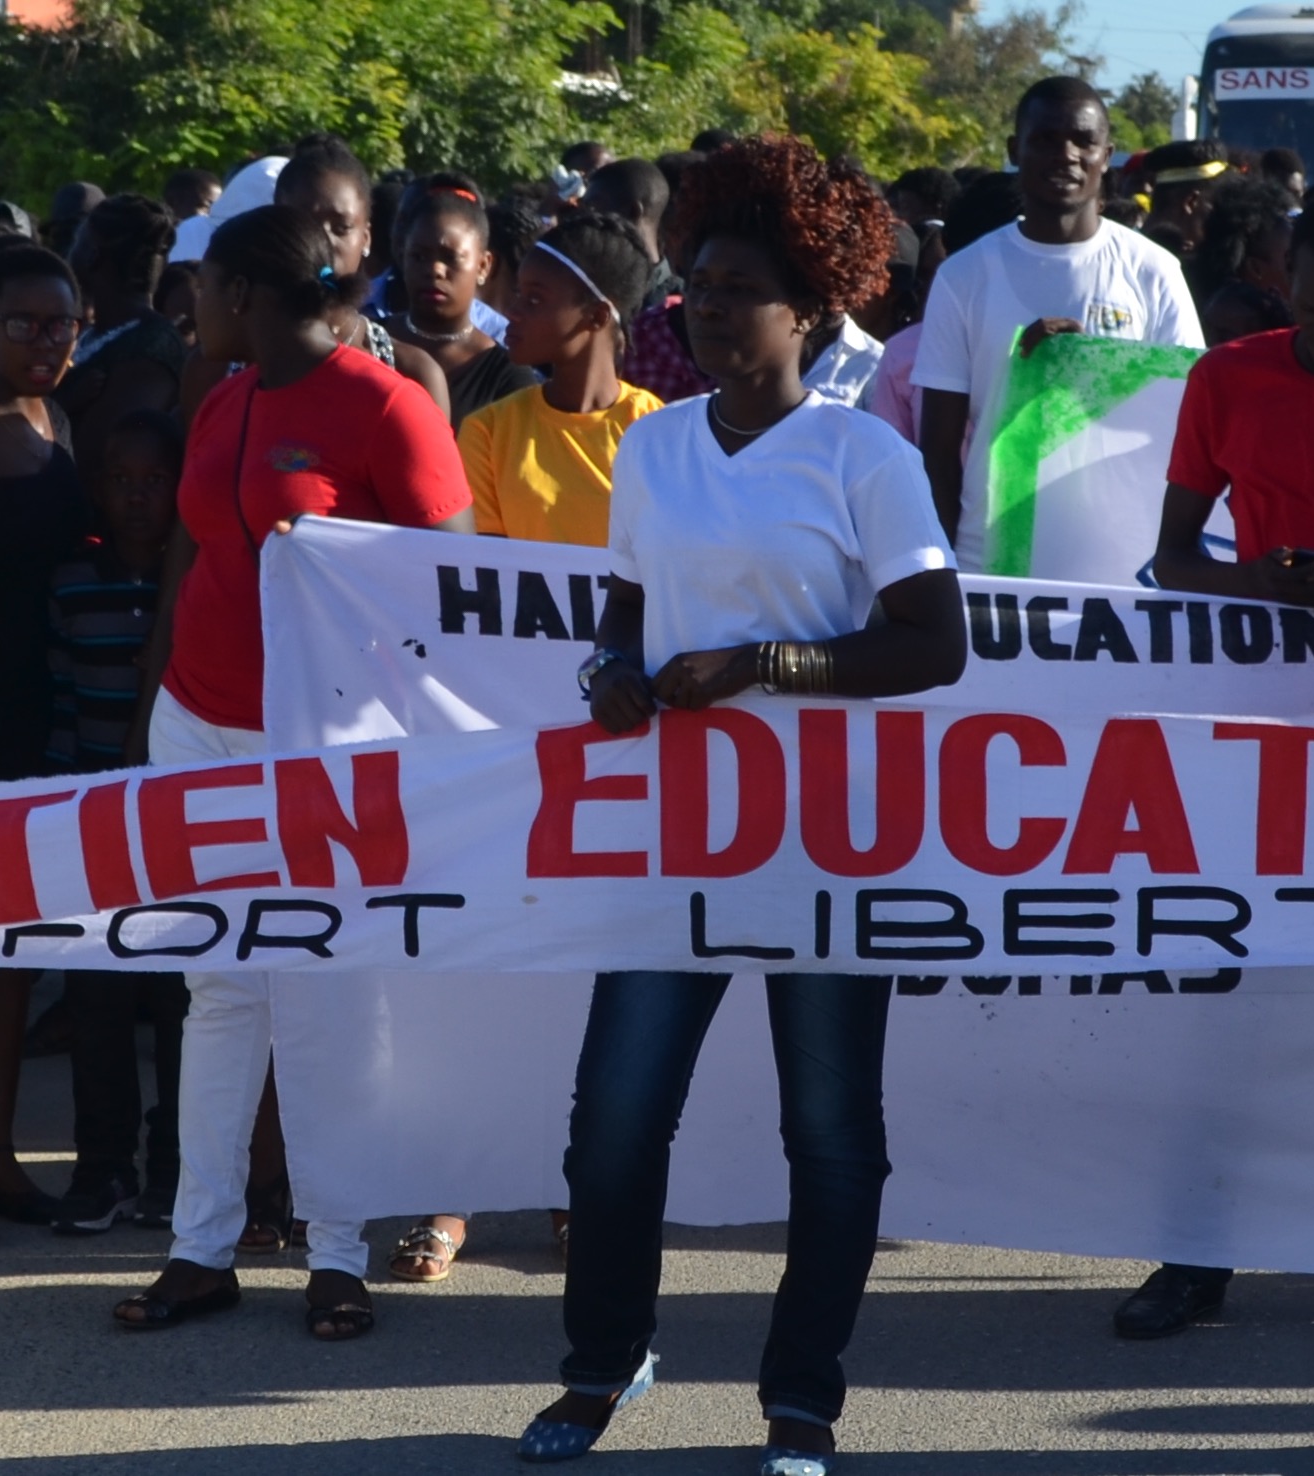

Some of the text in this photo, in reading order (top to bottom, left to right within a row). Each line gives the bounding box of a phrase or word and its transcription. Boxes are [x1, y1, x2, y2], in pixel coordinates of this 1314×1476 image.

[1220, 69, 1310, 90] SANS
[437, 565, 609, 642] HAI
[2, 893, 466, 960] FORT
